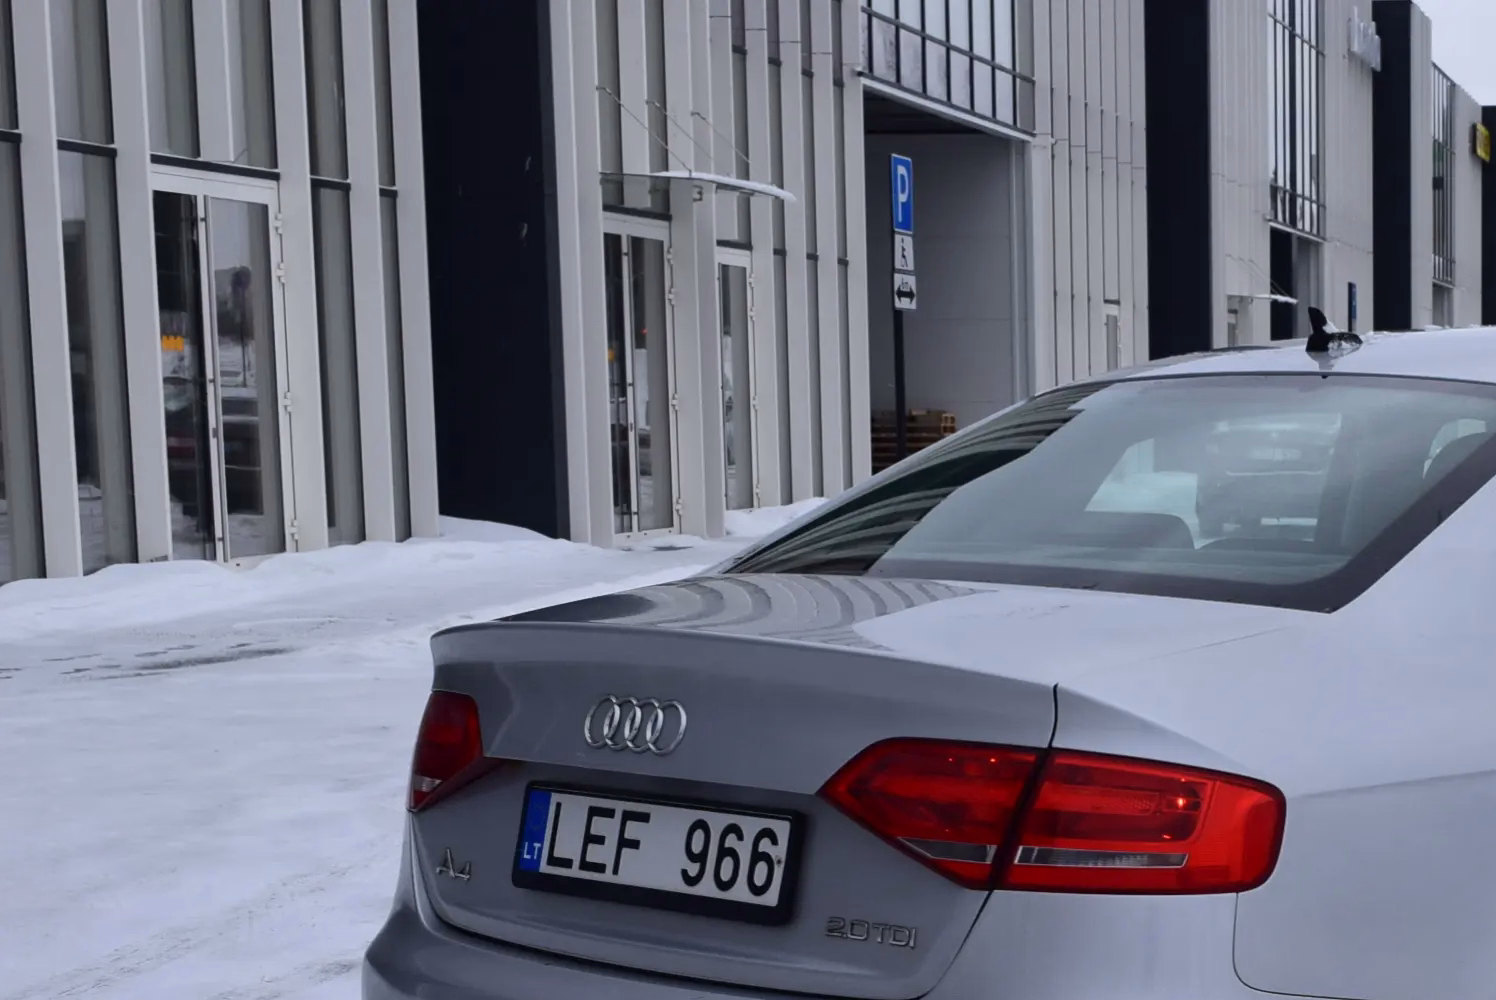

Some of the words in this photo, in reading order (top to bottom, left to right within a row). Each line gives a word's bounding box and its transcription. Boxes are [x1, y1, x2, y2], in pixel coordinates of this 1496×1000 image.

[896, 164, 909, 223] P
[435, 847, 472, 881] A4
[523, 841, 541, 860] LT
[546, 801, 651, 876] LEF
[680, 818, 779, 897] 966
[824, 916, 869, 942] 2.0
[872, 922, 917, 950] TDI
